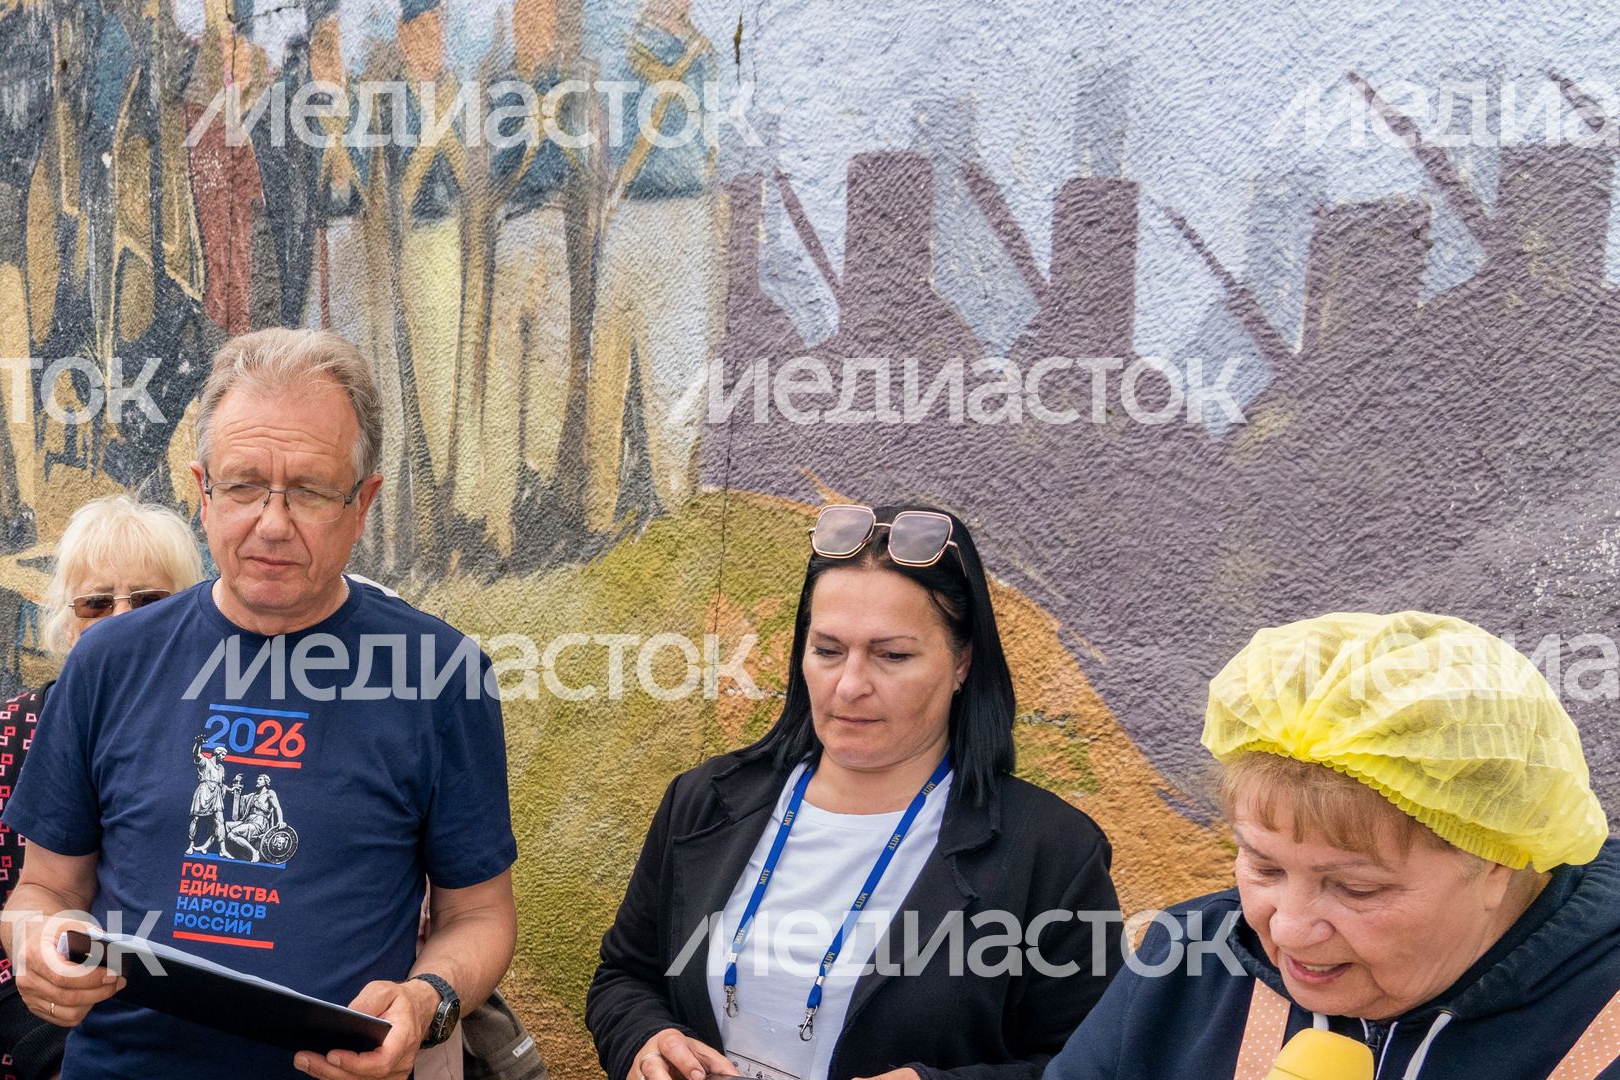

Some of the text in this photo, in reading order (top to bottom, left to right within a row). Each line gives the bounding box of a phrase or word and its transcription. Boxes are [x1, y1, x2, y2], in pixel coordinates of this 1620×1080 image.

[201, 714, 306, 758] 2026
[181, 861, 218, 881] ГОД
[179, 879, 280, 904] ЕДИНСТВА
[175, 896, 267, 919] НАРОДОВ
[173, 912, 252, 935] РОССИИ
